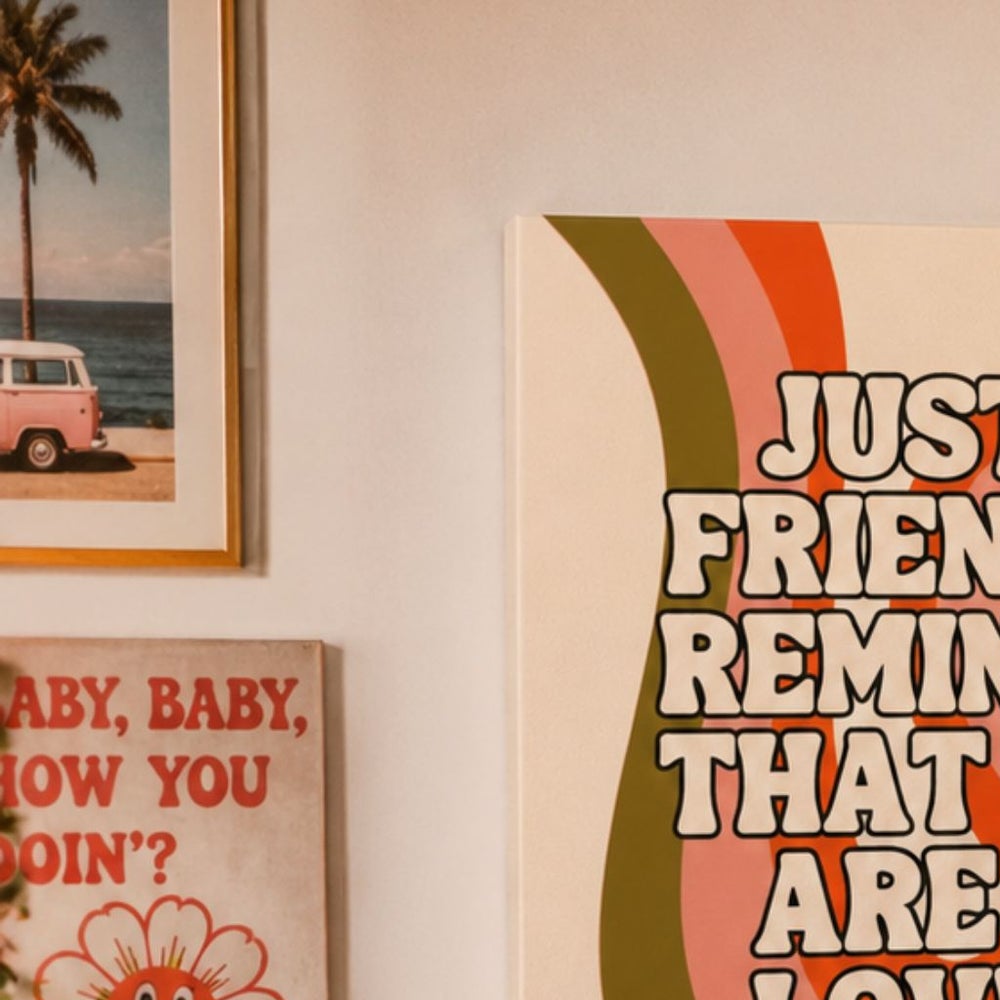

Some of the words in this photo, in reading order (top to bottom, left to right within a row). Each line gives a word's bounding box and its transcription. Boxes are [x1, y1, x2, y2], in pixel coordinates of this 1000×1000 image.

[0, 676, 129, 737] ABY,
[147, 677, 308, 738] BABY,
[147, 755, 271, 808] YOU
[656, 726, 991, 838] THAT
[751, 845, 1000, 957] ARE
